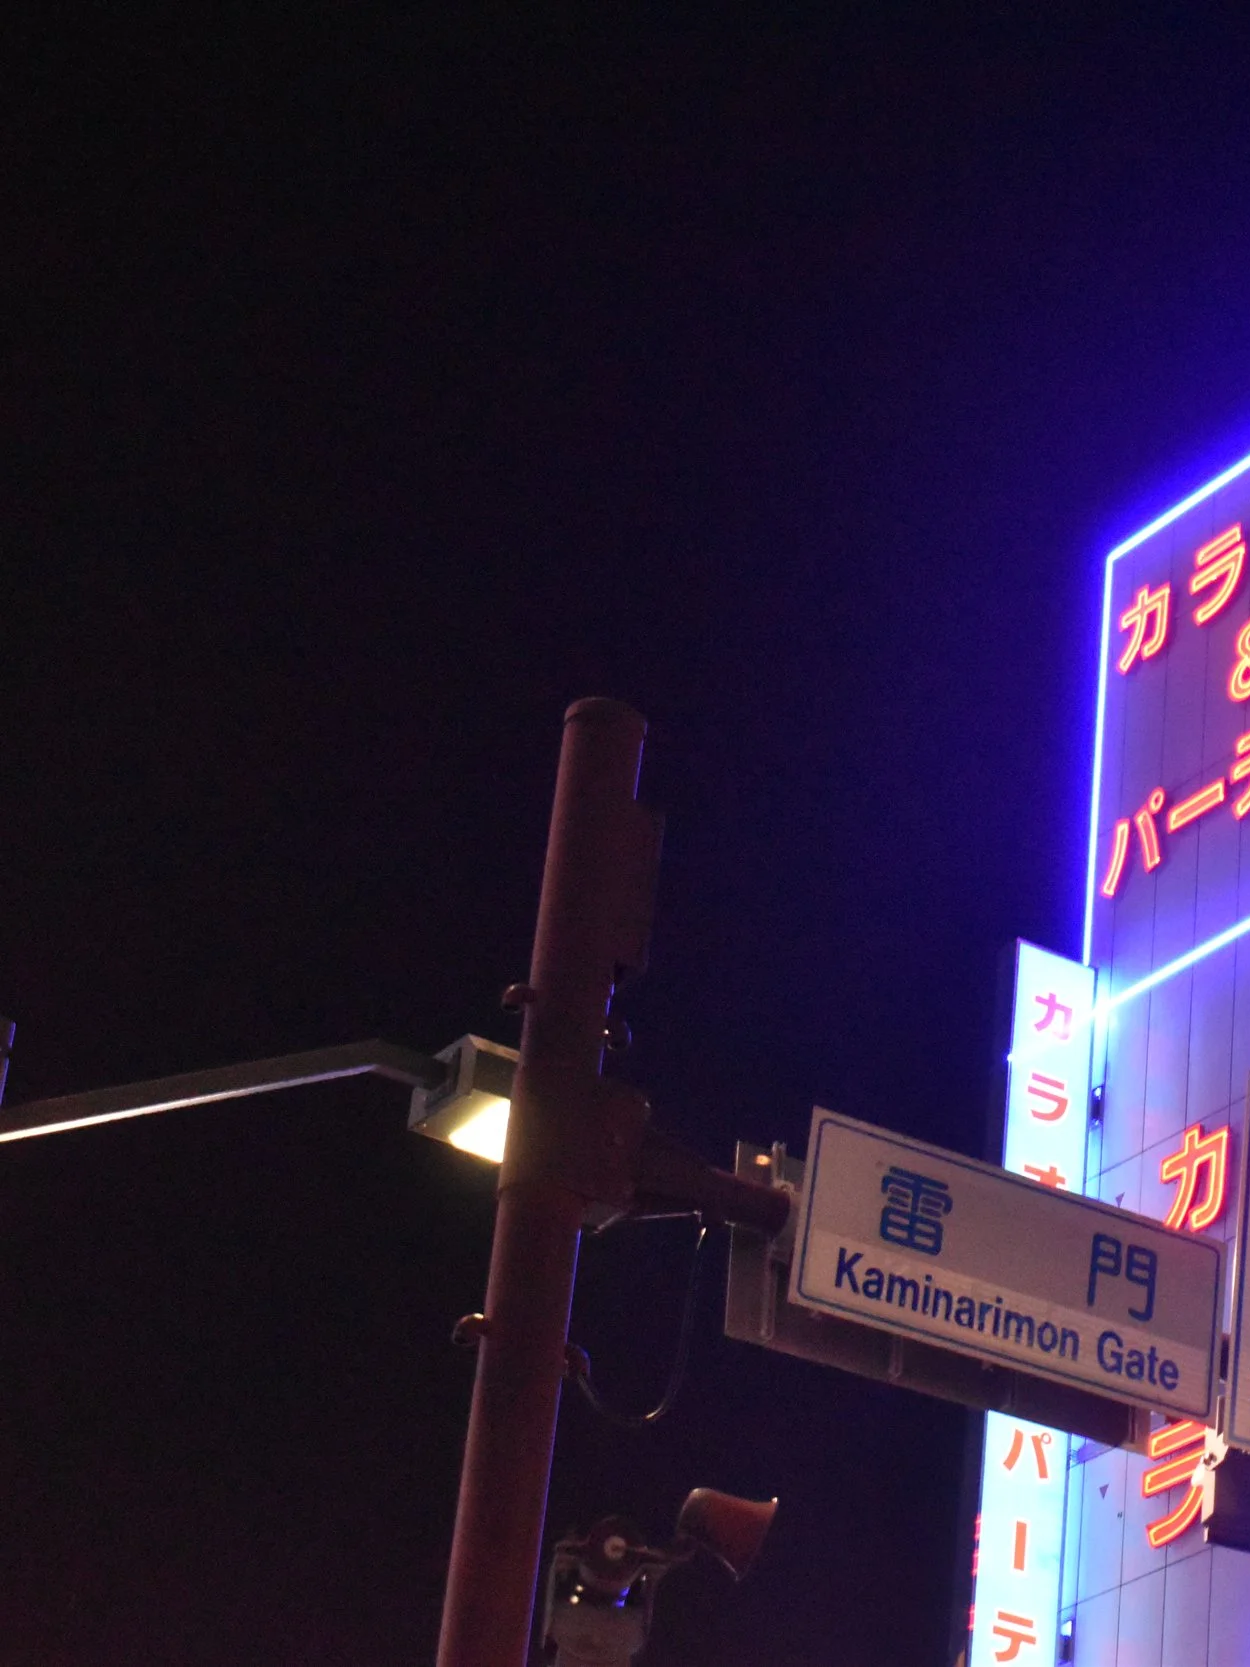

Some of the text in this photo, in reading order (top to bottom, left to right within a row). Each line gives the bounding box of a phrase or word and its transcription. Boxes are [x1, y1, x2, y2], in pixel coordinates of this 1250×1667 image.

[834, 1246, 1180, 1392] Kaminarimon Gate
[880, 1165, 1159, 1323] 雷門
